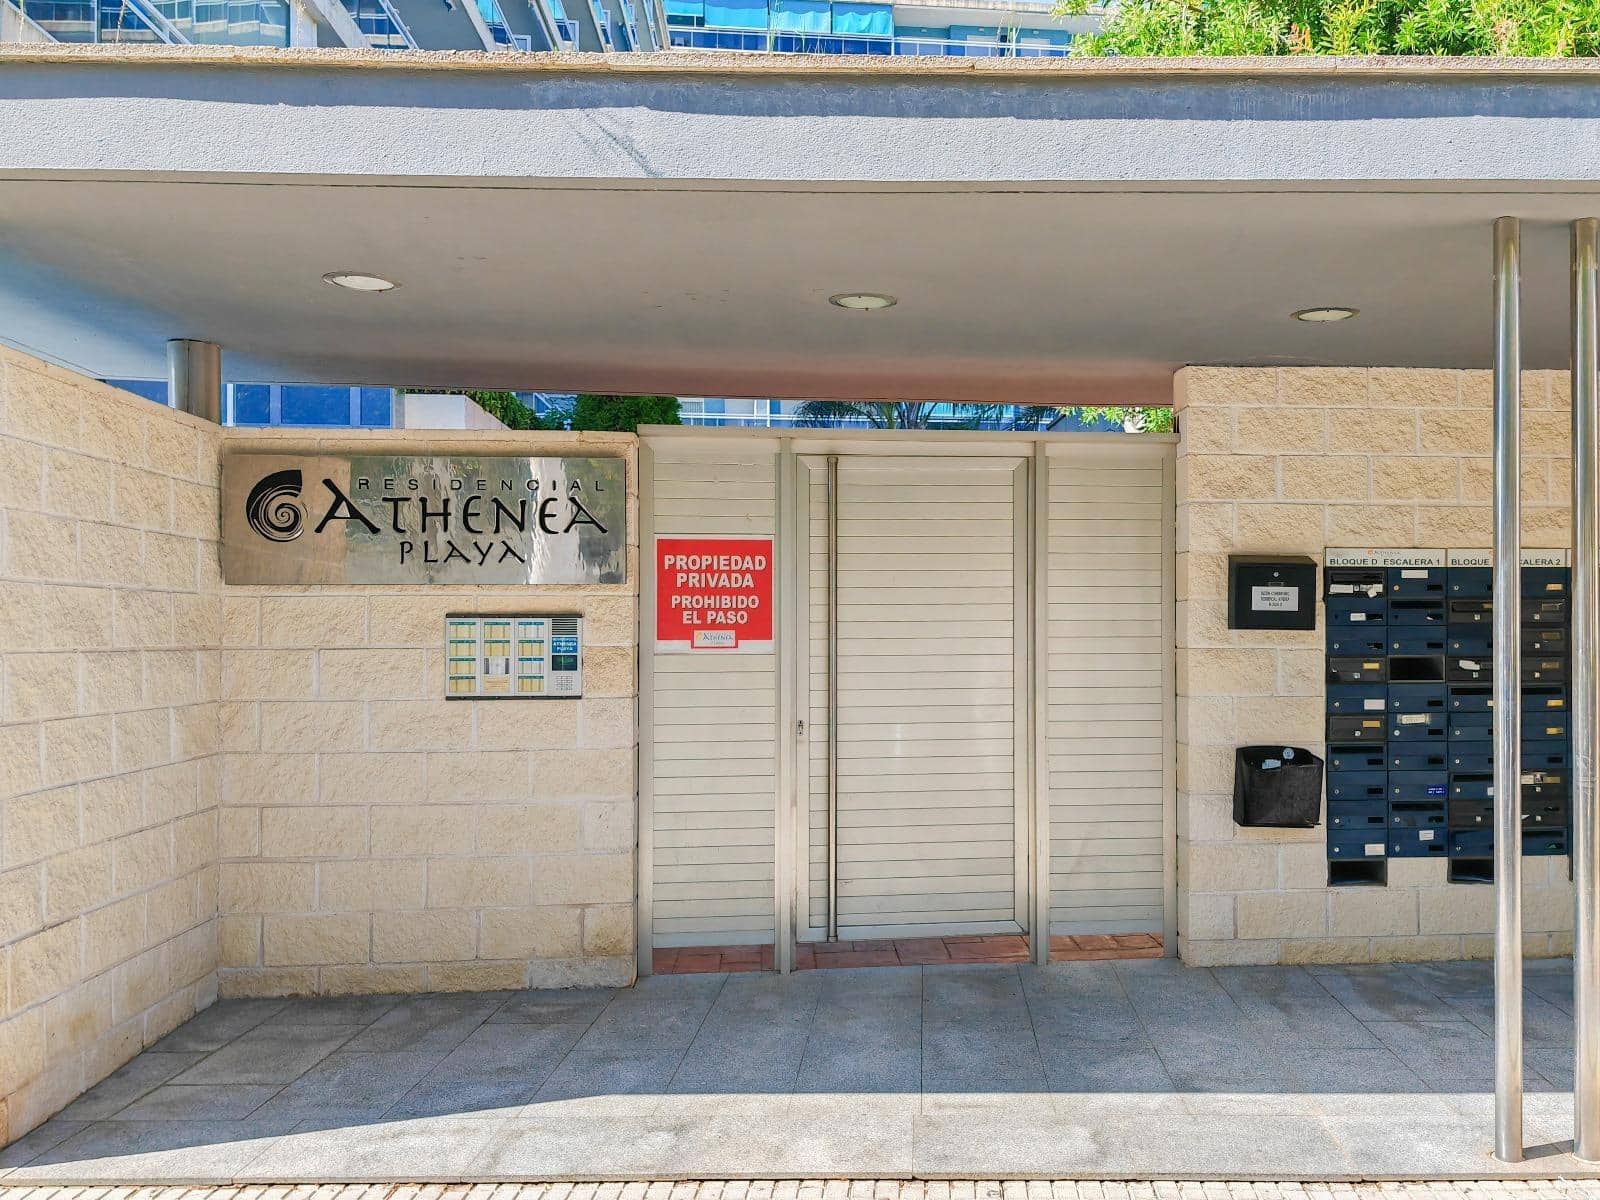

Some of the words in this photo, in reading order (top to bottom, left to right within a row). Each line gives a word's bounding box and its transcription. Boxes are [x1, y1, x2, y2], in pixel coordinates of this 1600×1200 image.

[358, 478, 605, 491] RESIDENCIAL
[314, 477, 608, 534] ATHENEA
[399, 540, 526, 566] PLAYA
[664, 555, 766, 571] PROPIEDAD
[1329, 558, 1368, 566] BLOQUE
[1371, 558, 1378, 566] D
[1383, 558, 1433, 566] ESCALERA
[1451, 558, 1490, 566] BLOQUE
[1555, 558, 1561, 566] 2
[676, 573, 755, 588] PRIVADA
[671, 595, 760, 609] PROHIBIDO
[682, 611, 702, 625] EL
[707, 611, 748, 625] PASO
